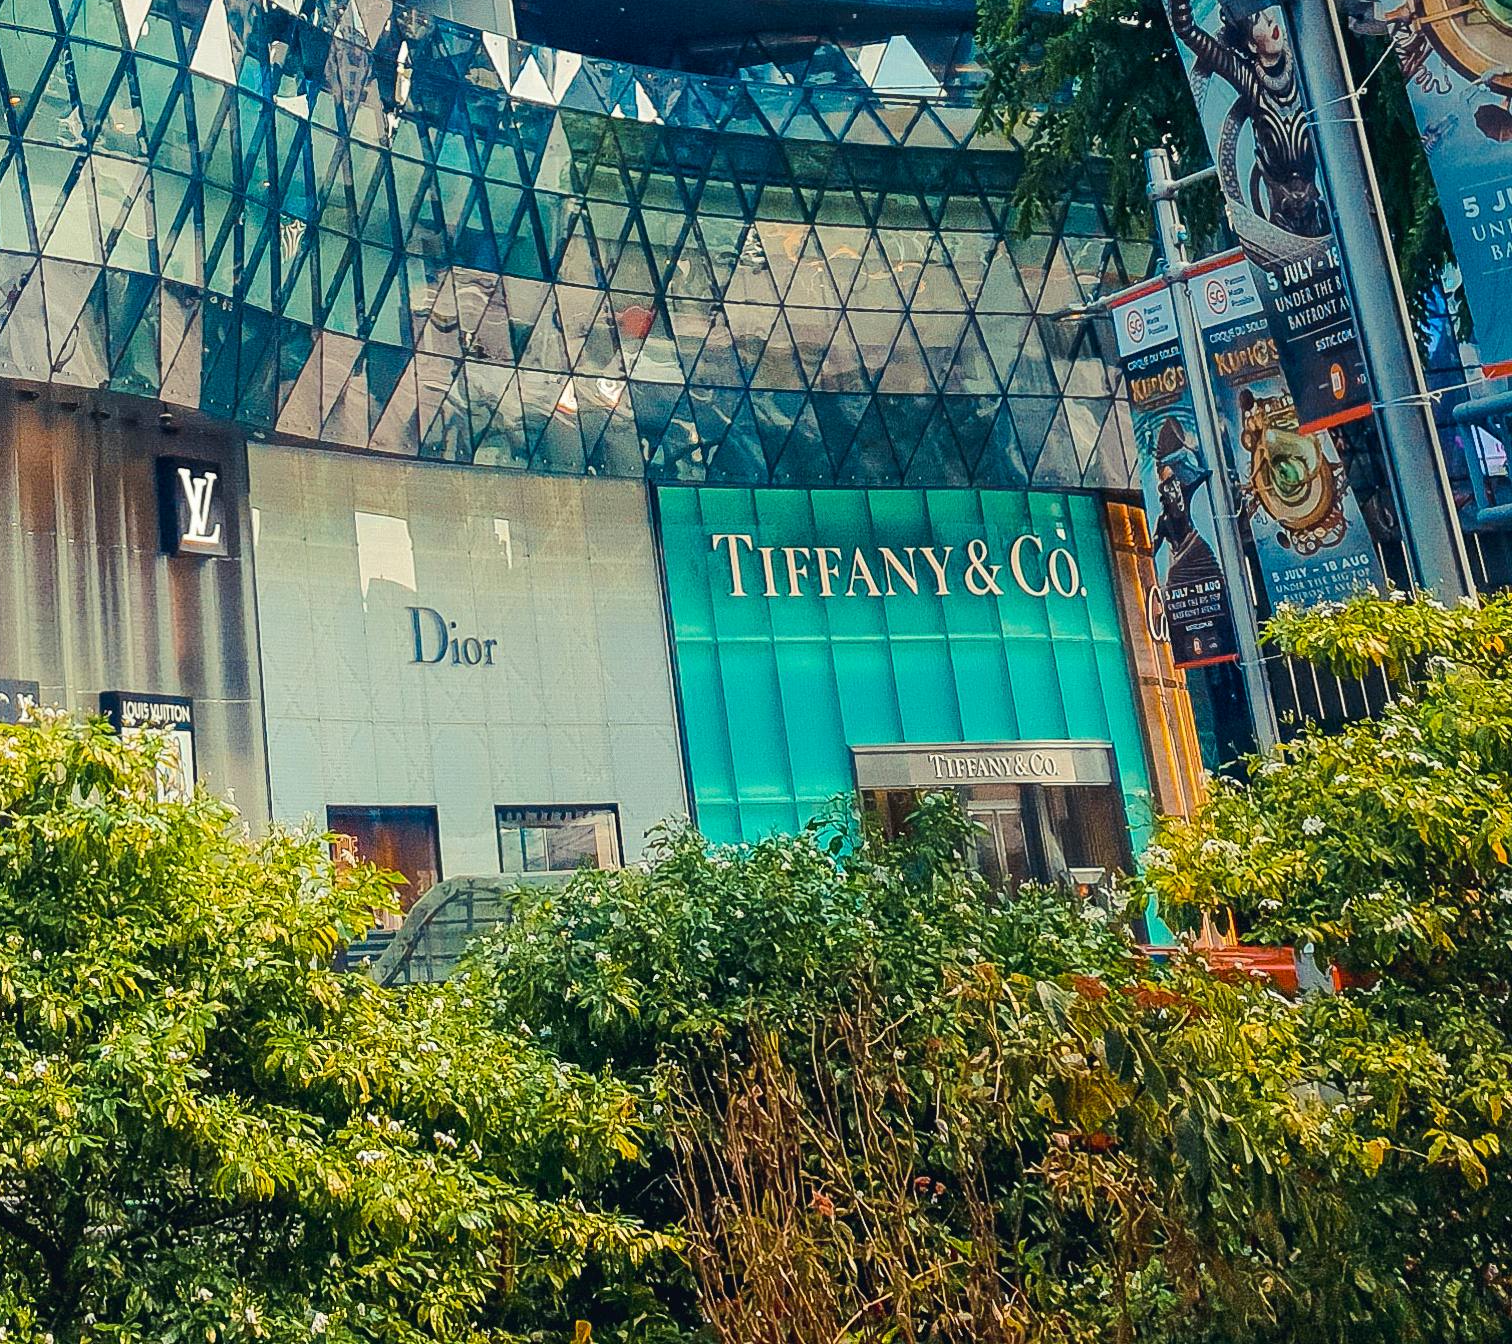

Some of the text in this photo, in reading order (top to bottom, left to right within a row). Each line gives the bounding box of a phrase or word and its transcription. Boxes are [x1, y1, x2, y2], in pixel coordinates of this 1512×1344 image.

[1462, 196, 1480, 218] 5
[1266, 271, 1279, 291] 5
[1283, 256, 1313, 286] JULY
[1274, 287, 1314, 313] UNDER
[1314, 279, 1334, 299] THE
[1288, 299, 1339, 331] BAYFRONT
[712, 534, 953, 597] TIFFANY
[1284, 567, 1307, 581] JULY
[1342, 554, 1369, 569] AUG
[404, 607, 498, 665] Dior
[123, 701, 190, 723] LOUIS VUITTON
[929, 753, 1012, 778] TIFFANY
